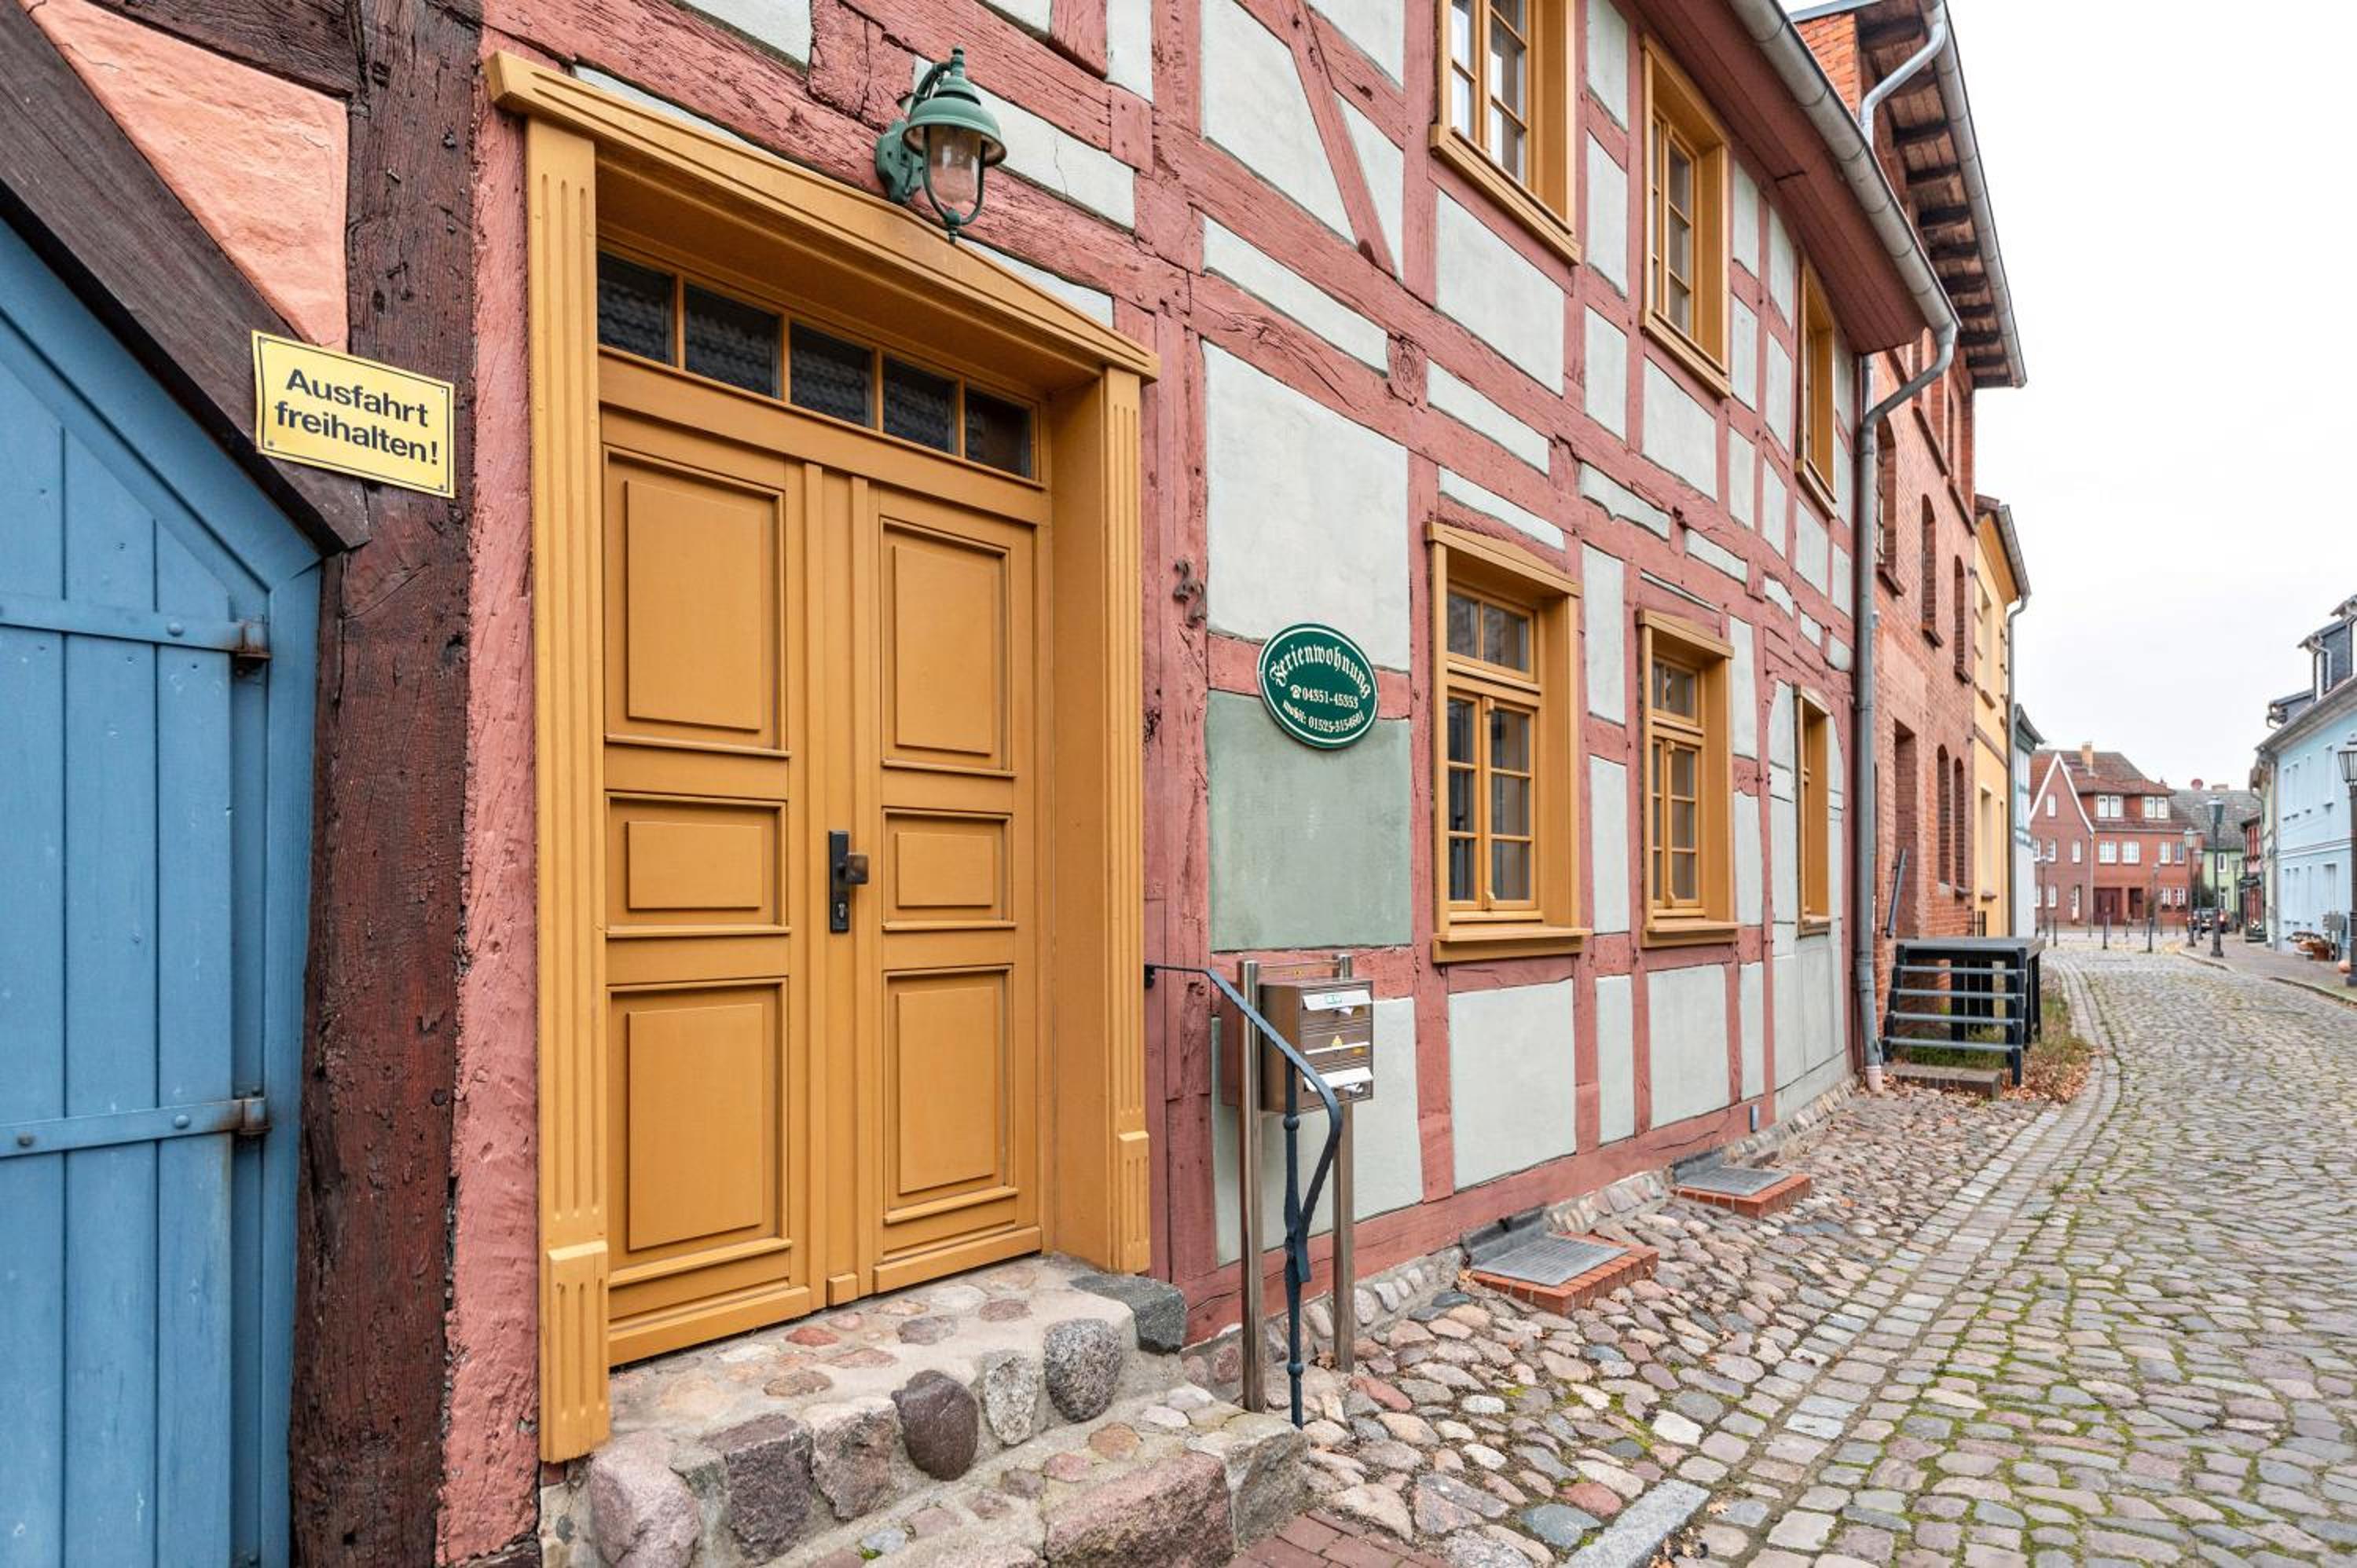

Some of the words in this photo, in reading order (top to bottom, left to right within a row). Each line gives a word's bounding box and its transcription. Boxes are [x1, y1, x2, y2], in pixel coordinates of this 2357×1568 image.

[286, 368, 428, 427] Ausfahrt
[275, 401, 438, 465] freihalten!
[1269, 643, 1371, 700] Ferienwohnung
